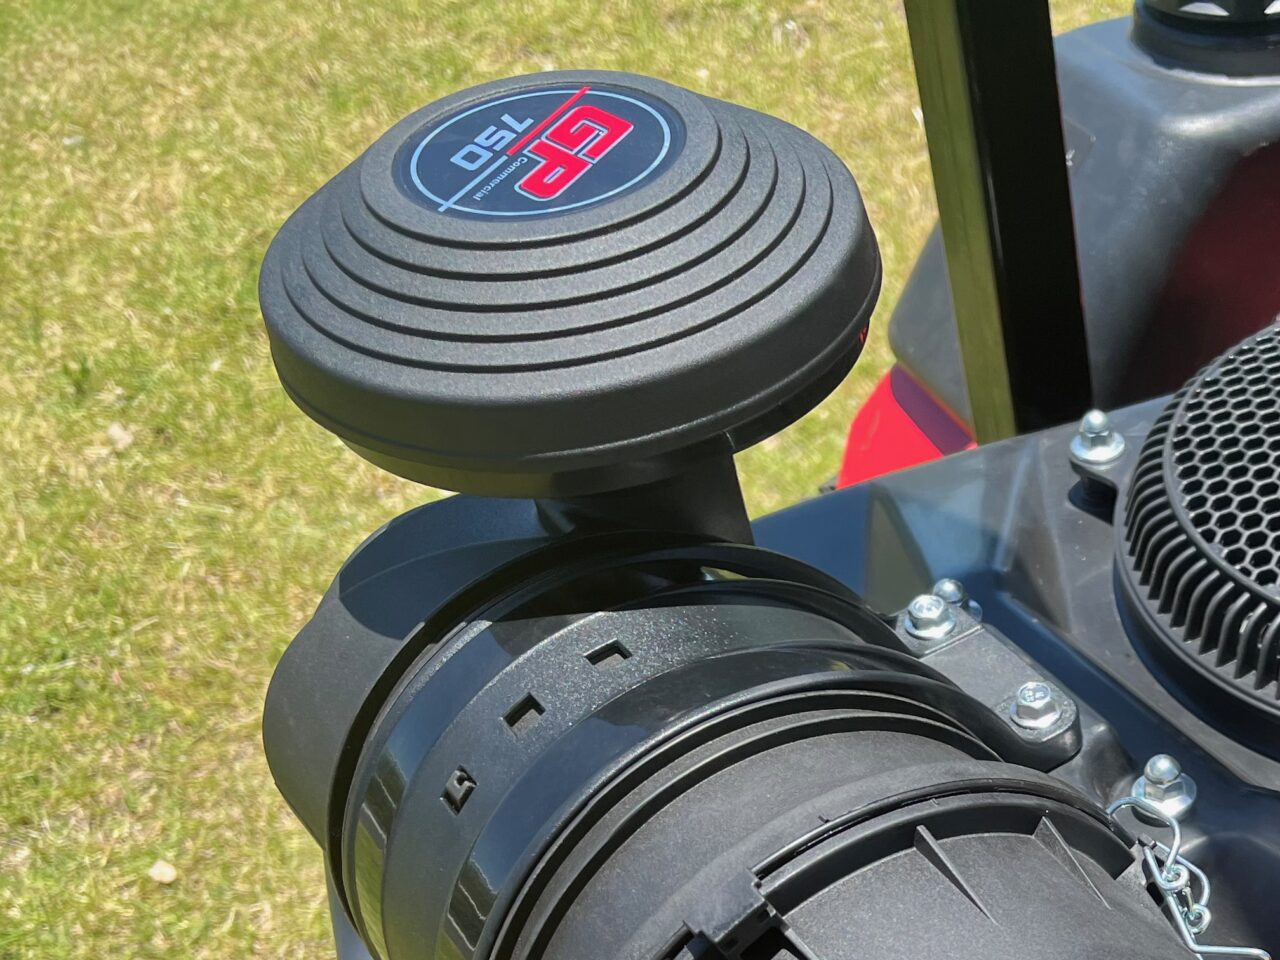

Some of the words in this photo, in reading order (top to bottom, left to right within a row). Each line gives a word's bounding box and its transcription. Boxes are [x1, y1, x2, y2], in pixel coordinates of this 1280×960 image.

[450, 113, 534, 171] 750
[514, 104, 635, 201] GP
[474, 156, 528, 201] Commercial
